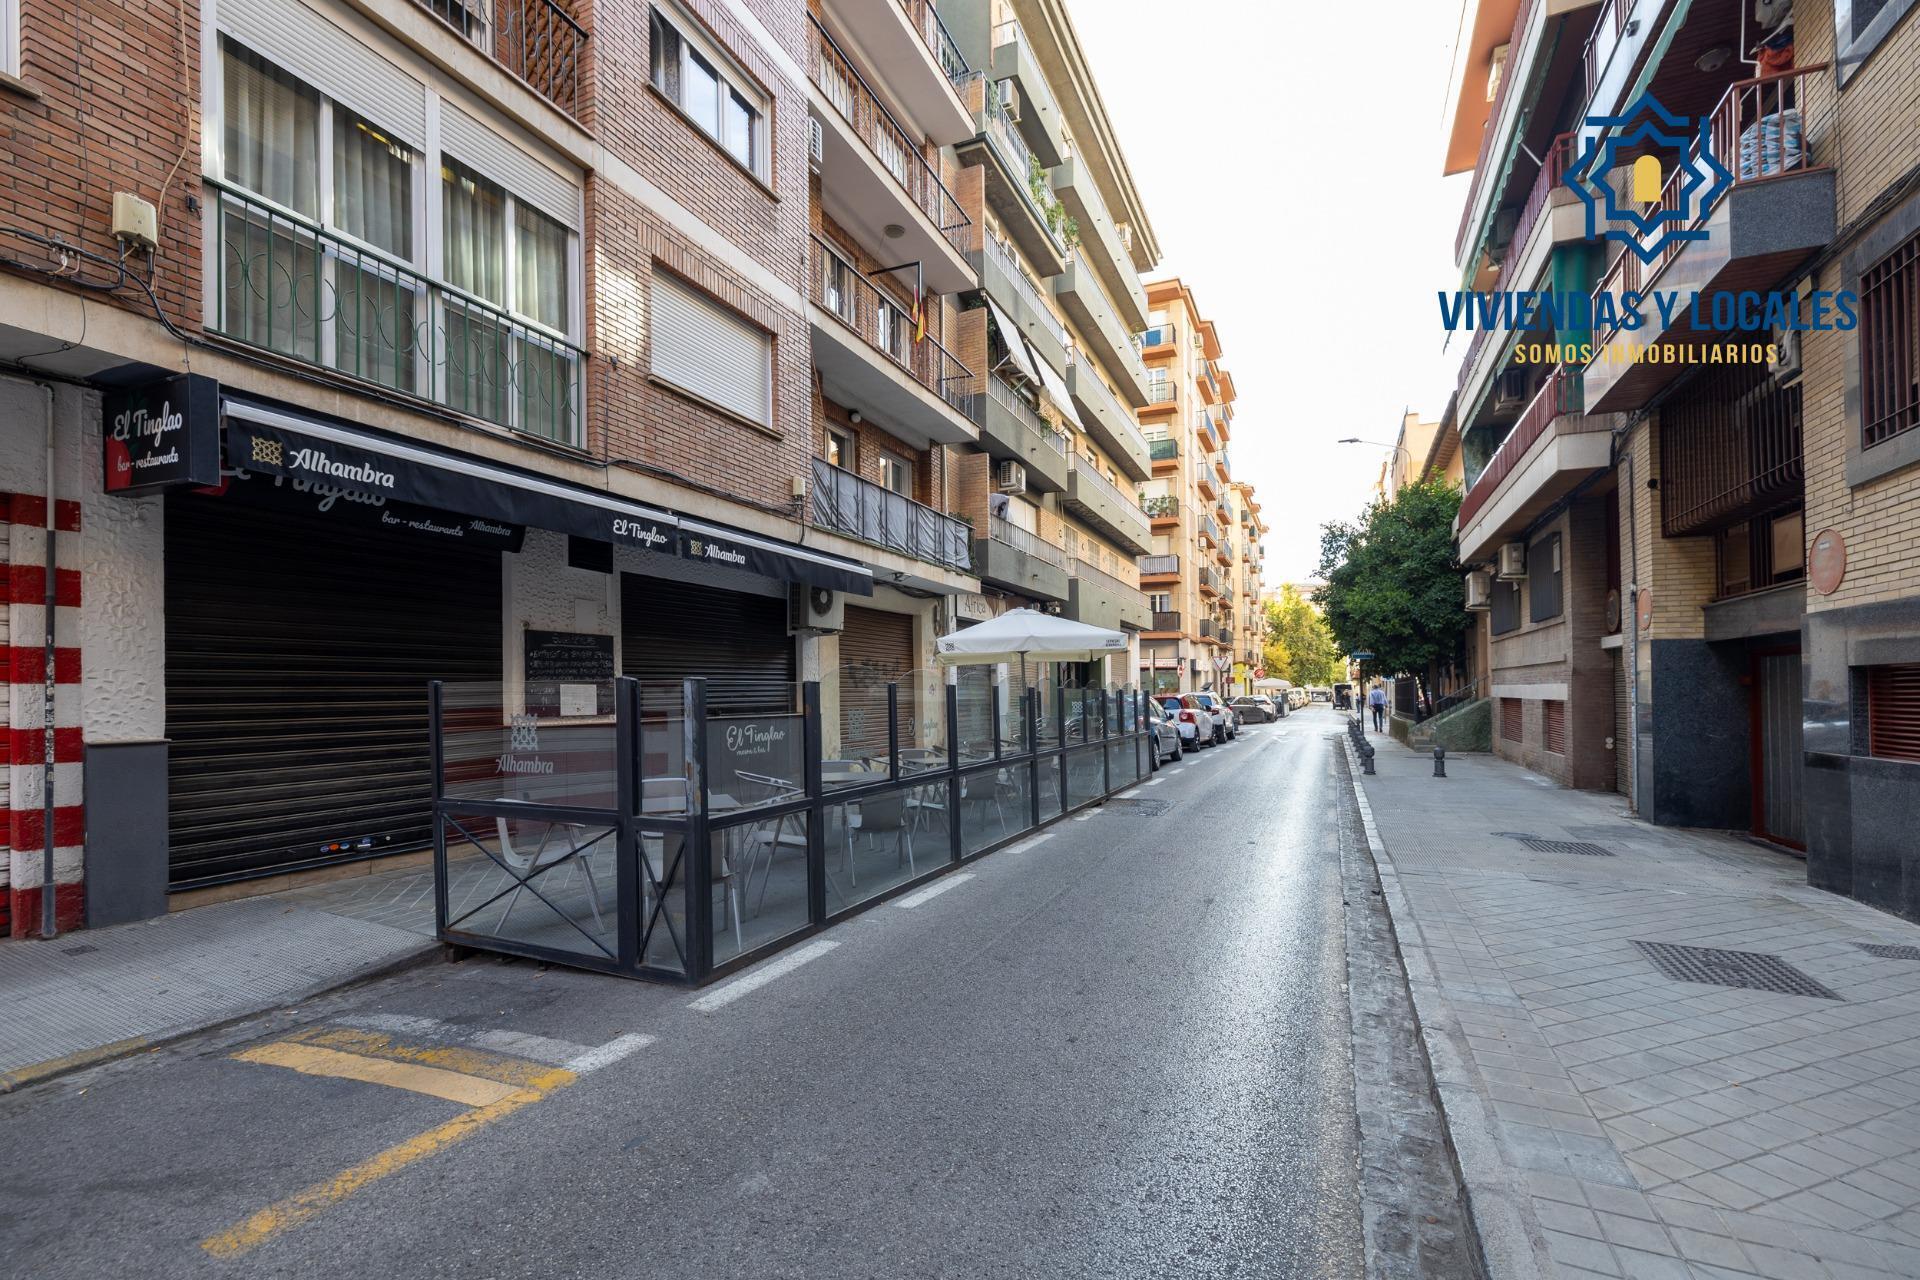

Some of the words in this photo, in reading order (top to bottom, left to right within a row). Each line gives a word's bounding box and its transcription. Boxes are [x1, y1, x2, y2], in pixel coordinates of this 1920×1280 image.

[113, 410, 130, 441] El
[132, 400, 183, 447] Tinglao
[116, 455, 130, 473] bar
[136, 446, 179, 469] restaurante
[288, 447, 395, 489] Alhambra
[382, 510, 400, 525] bar
[408, 519, 464, 537] restaurante
[468, 519, 512, 537] Alhambra
[613, 519, 628, 535] El
[629, 522, 668, 548] Tinglao
[704, 542, 746, 565] Alhambra
[726, 725, 744, 751] El
[744, 724, 786, 753] Tinglao
[495, 754, 554, 774] Alhambra
